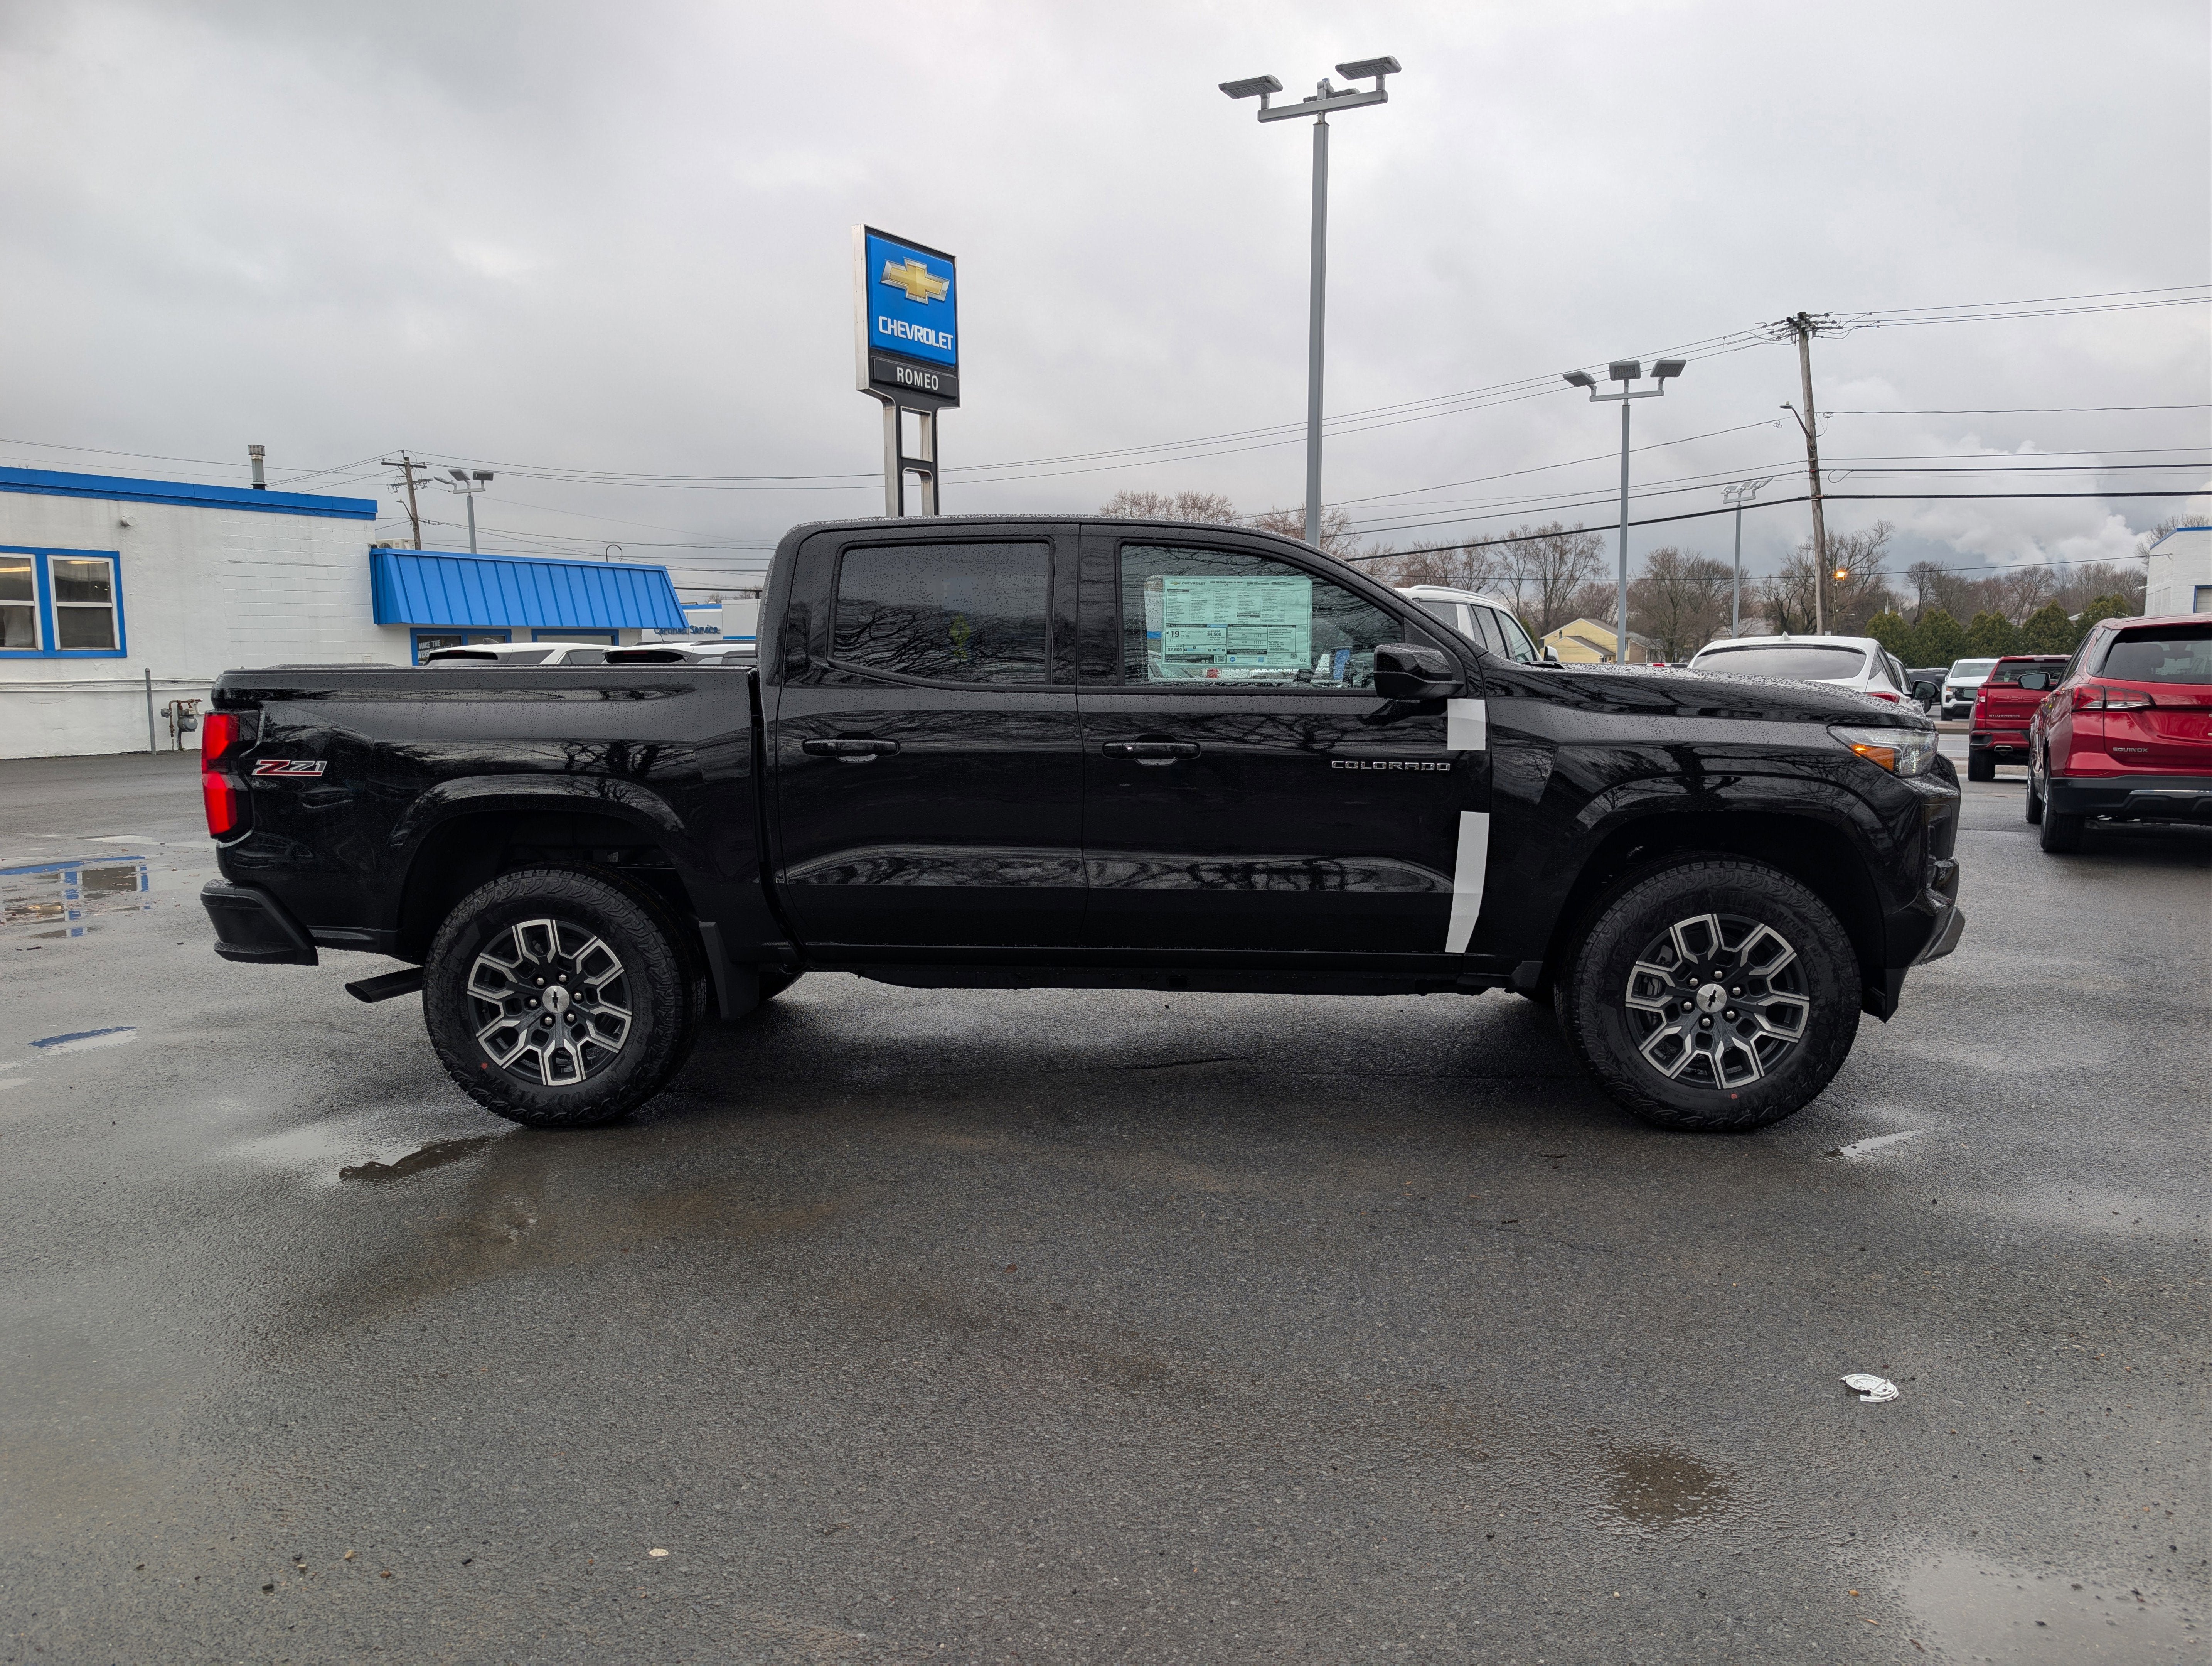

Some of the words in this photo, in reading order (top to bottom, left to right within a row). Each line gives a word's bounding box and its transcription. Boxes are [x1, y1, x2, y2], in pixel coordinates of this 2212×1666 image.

[878, 316, 953, 351] CHEVROLET
[896, 366, 939, 391] ROMEO
[689, 625, 720, 634] Service
[419, 641, 430, 649] MAKE
[251, 759, 328, 776] Z71
[1331, 760, 1451, 771] COLORADO
